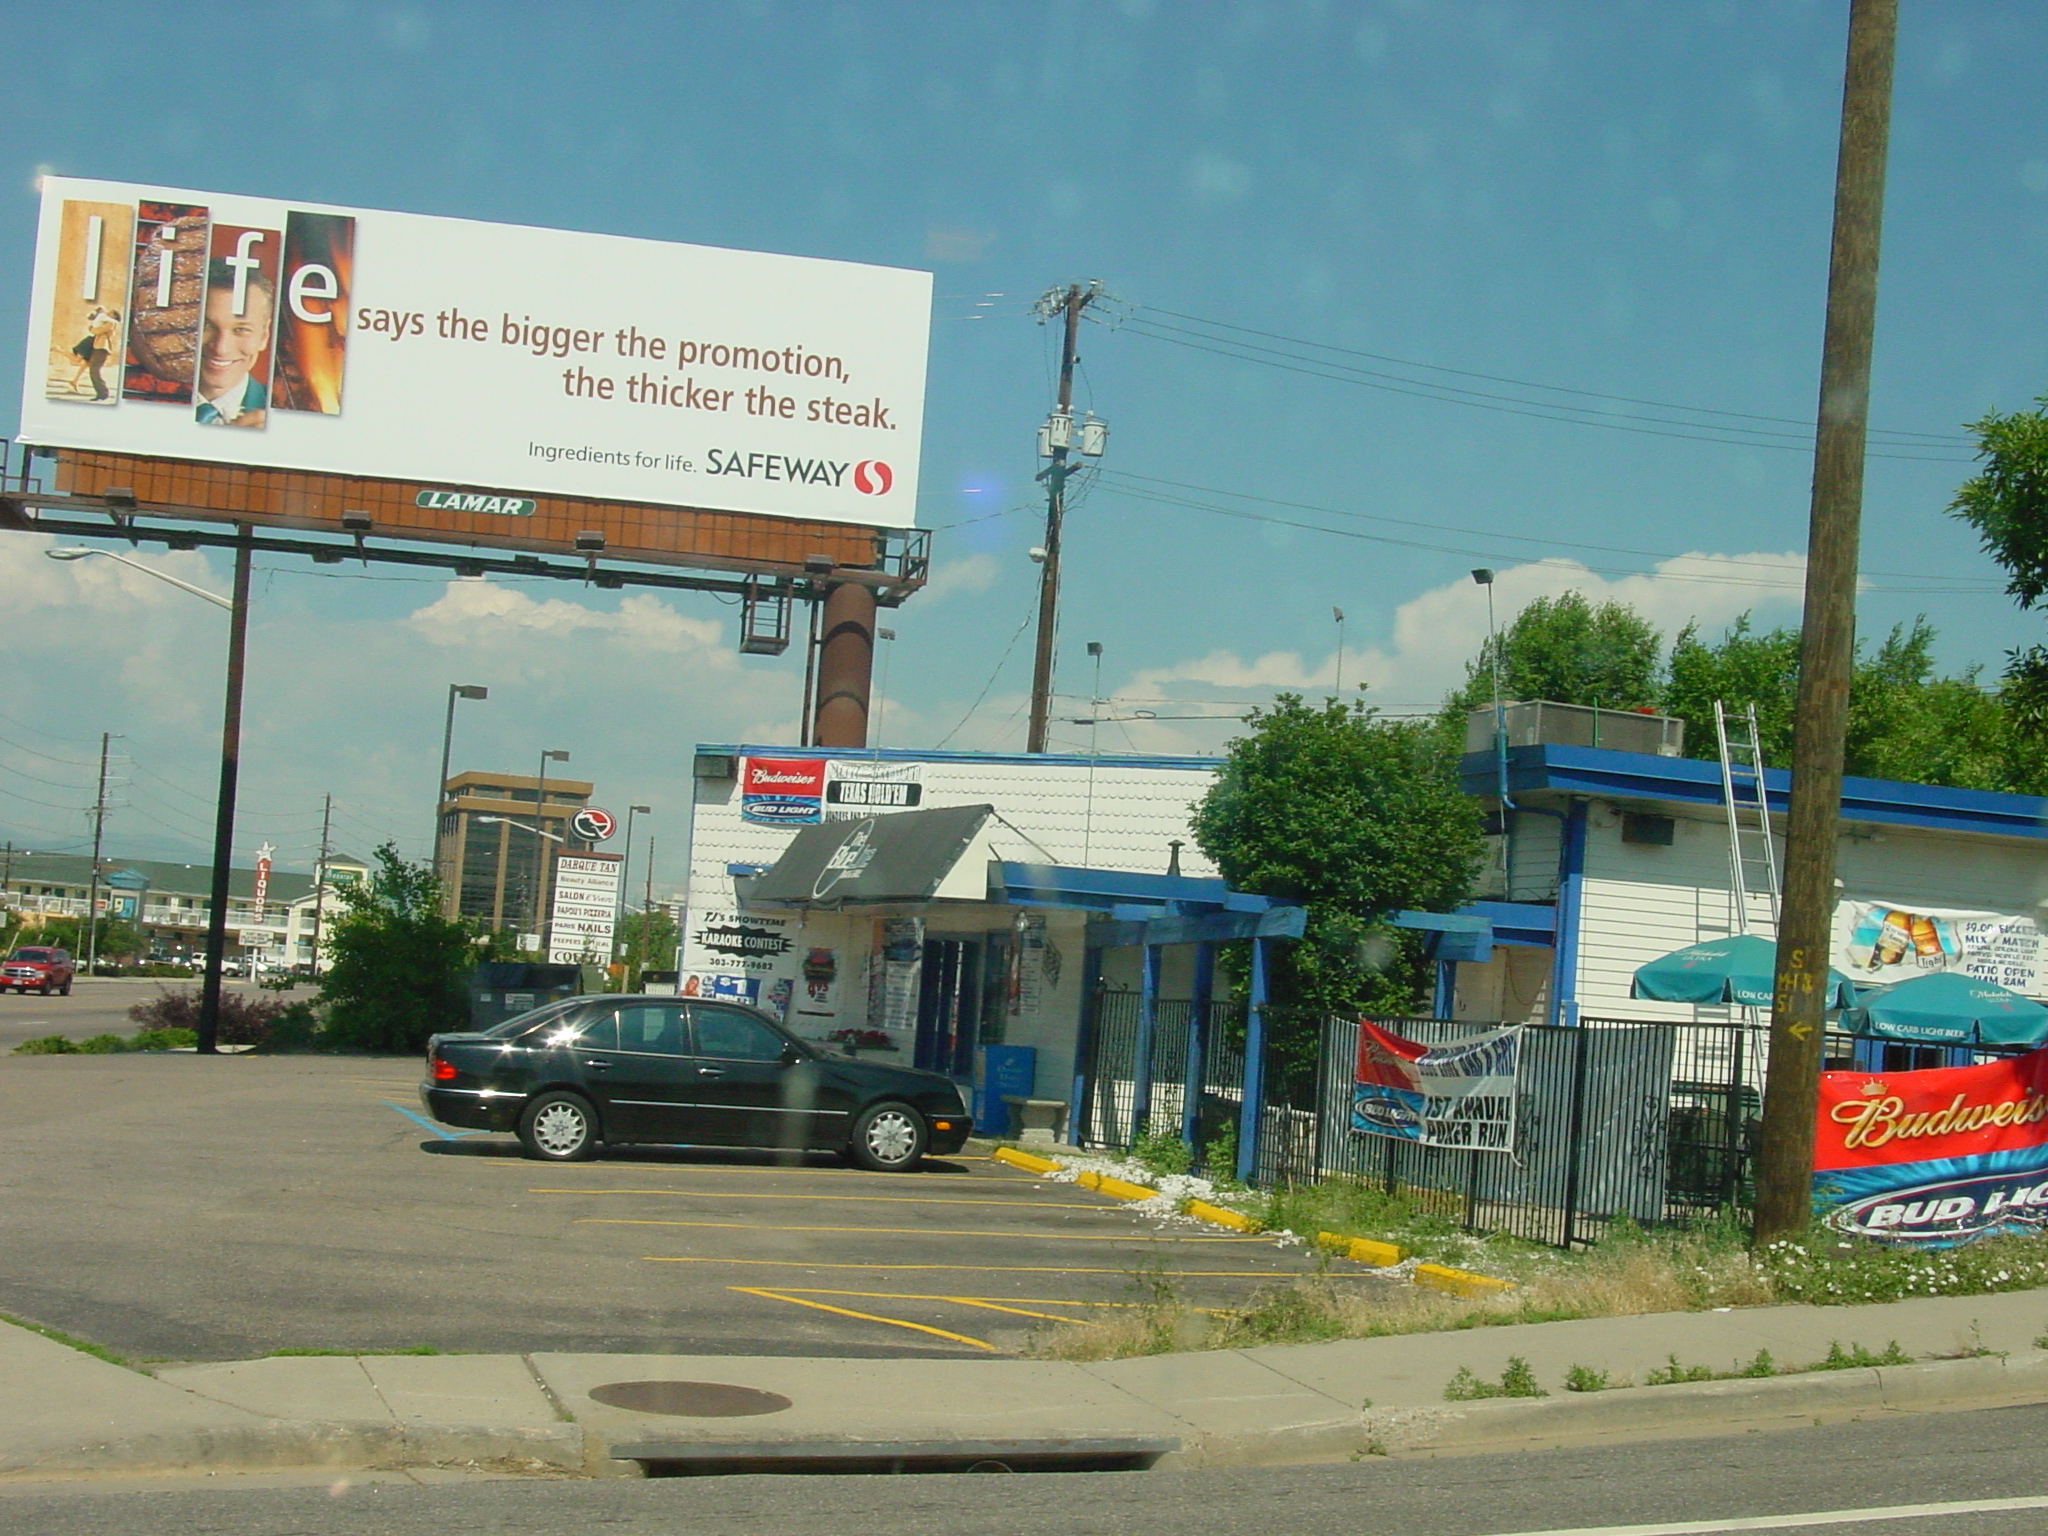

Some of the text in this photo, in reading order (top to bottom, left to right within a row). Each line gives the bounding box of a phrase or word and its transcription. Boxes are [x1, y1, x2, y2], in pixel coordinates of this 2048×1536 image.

[83, 215, 338, 323] life
[357, 306, 850, 384] says the bigger the promotion,
[562, 365, 897, 430] the thicker the steak.
[528, 441, 697, 473] Ingredients for life.
[705, 448, 850, 488] SAFEWAY
[427, 491, 523, 515] LAMAR
[751, 769, 817, 786] Budweiser
[840, 782, 867, 804] TEXAS
[752, 802, 818, 816] BUD LIGHT
[599, 862, 618, 873] TAN
[254, 862, 268, 922] LIQUORS
[558, 890, 585, 901] SALON
[577, 922, 612, 935] NAILS
[728, 914, 786, 927] SHOWTYME
[701, 932, 784, 951] KARAOKE CONTEST
[1965, 935, 1987, 944] MIX
[2001, 936, 2039, 948] MATCH
[1791, 949, 1806, 969] S
[1966, 963, 2035, 978] PATIO OPEN
[1737, 989, 1756, 999] LOW
[1875, 1021, 1895, 1031] LOW
[1897, 1024, 1919, 1034] CARB
[1920, 1026, 1945, 1037] LIGHT
[1426, 1120, 1508, 1148] POKER RUN
[1866, 1196, 1976, 1228] BUD
